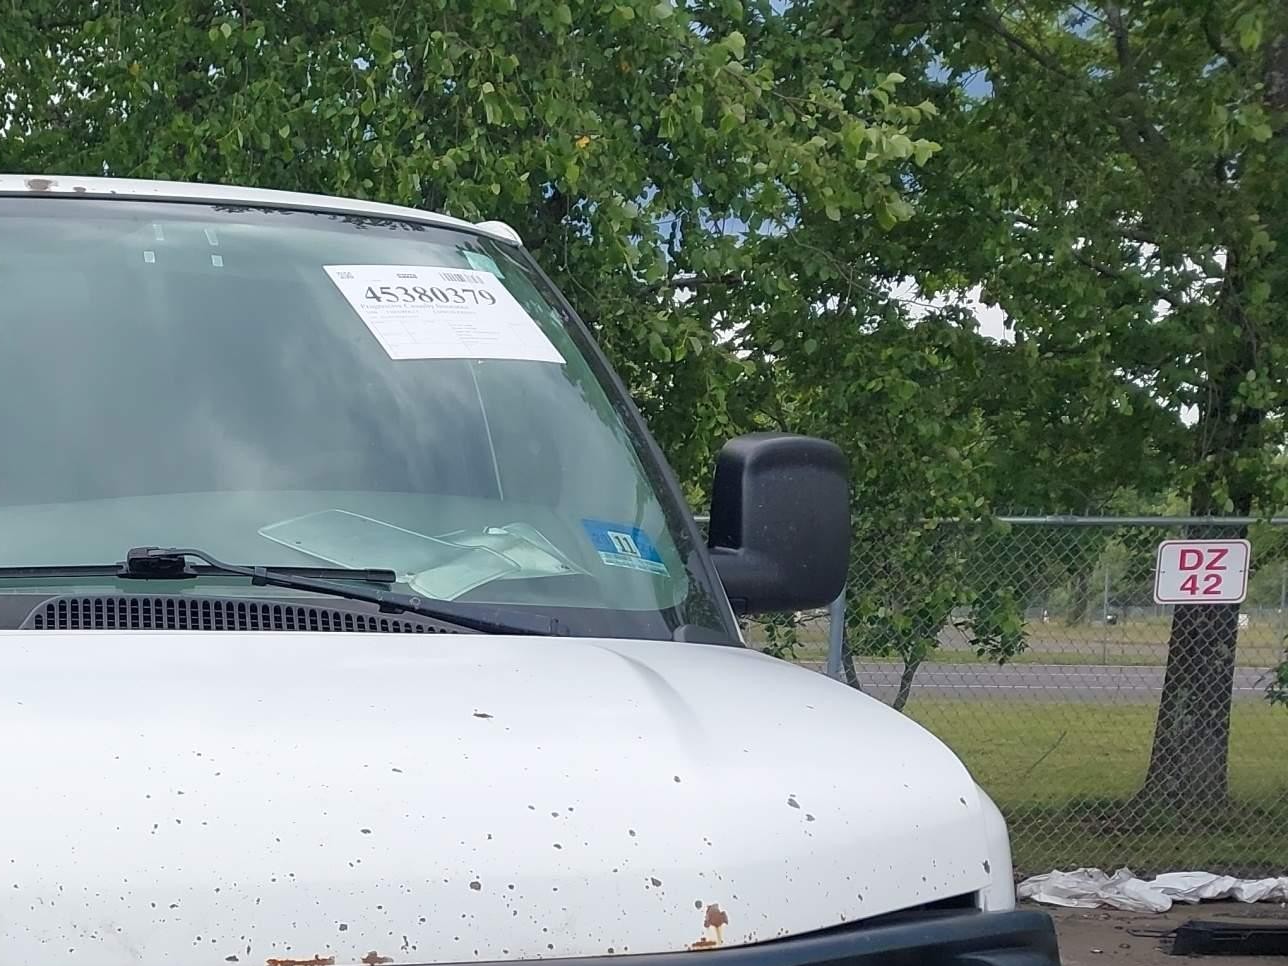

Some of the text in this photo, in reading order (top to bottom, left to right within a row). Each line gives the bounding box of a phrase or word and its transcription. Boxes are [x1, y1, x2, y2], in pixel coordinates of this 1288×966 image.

[365, 285, 497, 306] 45380379
[1179, 548, 1229, 571] DZ
[1180, 573, 1223, 595] 42
